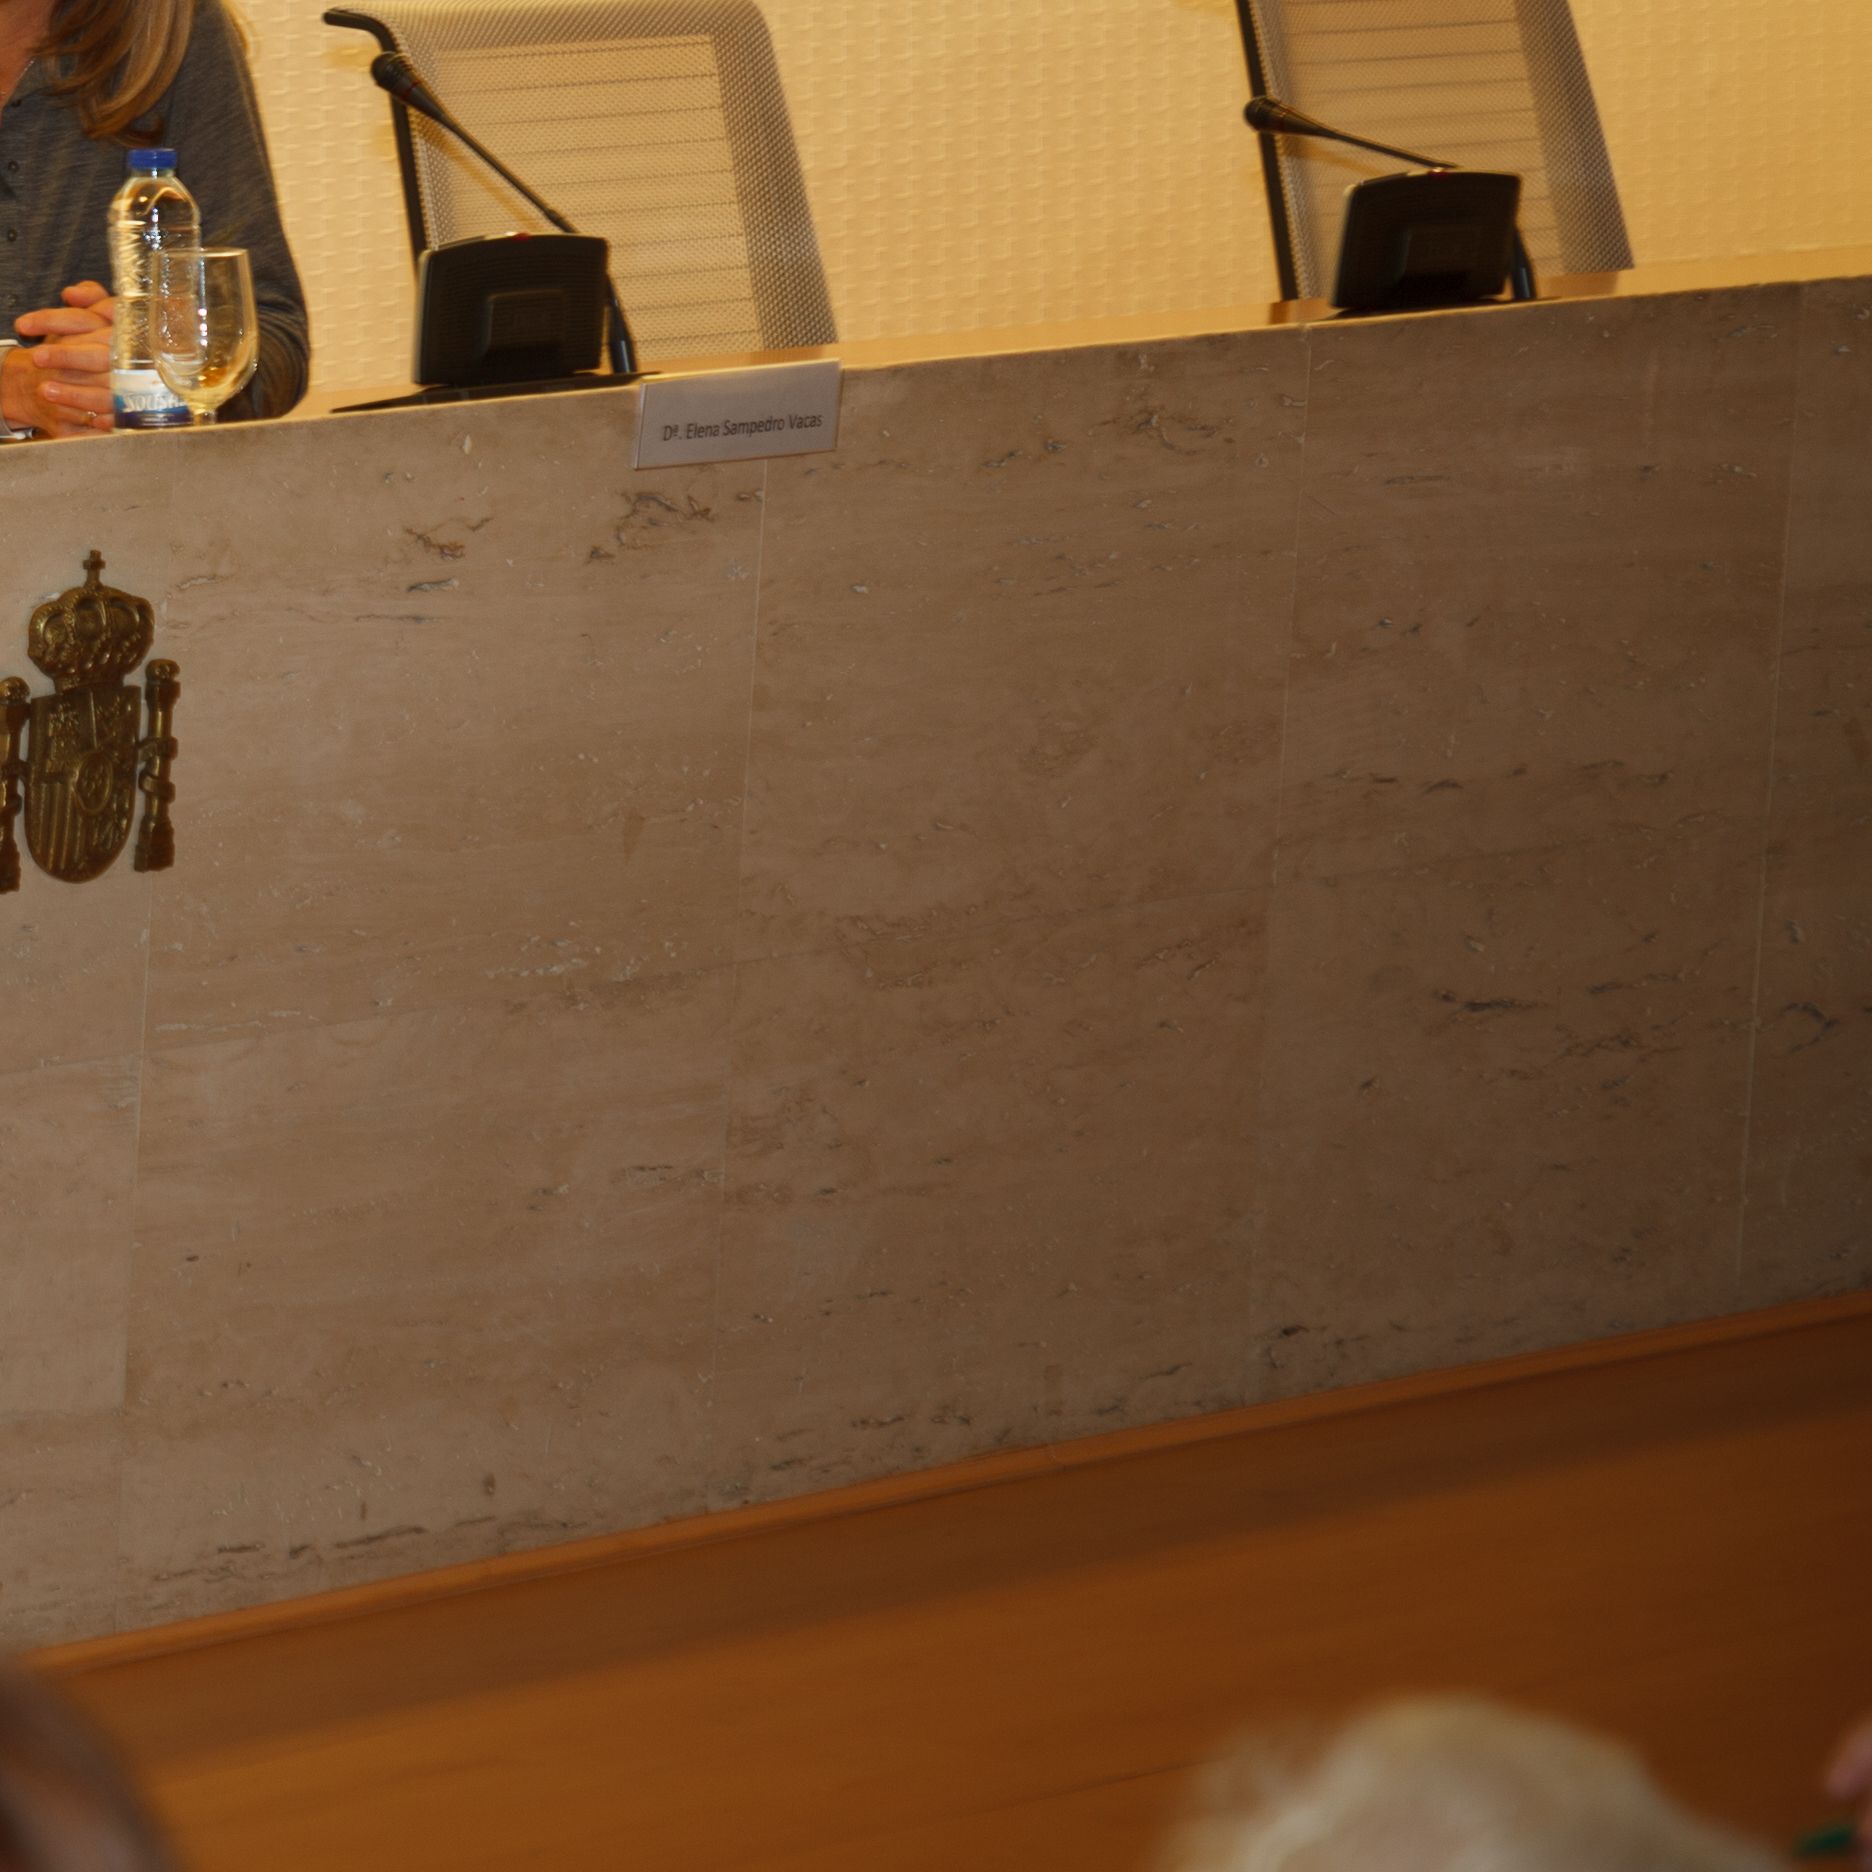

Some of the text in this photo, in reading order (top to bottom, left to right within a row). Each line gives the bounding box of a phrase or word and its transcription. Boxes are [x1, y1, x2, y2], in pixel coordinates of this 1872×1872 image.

[685, 422, 720, 440] Elena
[722, 416, 786, 437] Sampedro
[787, 414, 823, 430] Vacas
